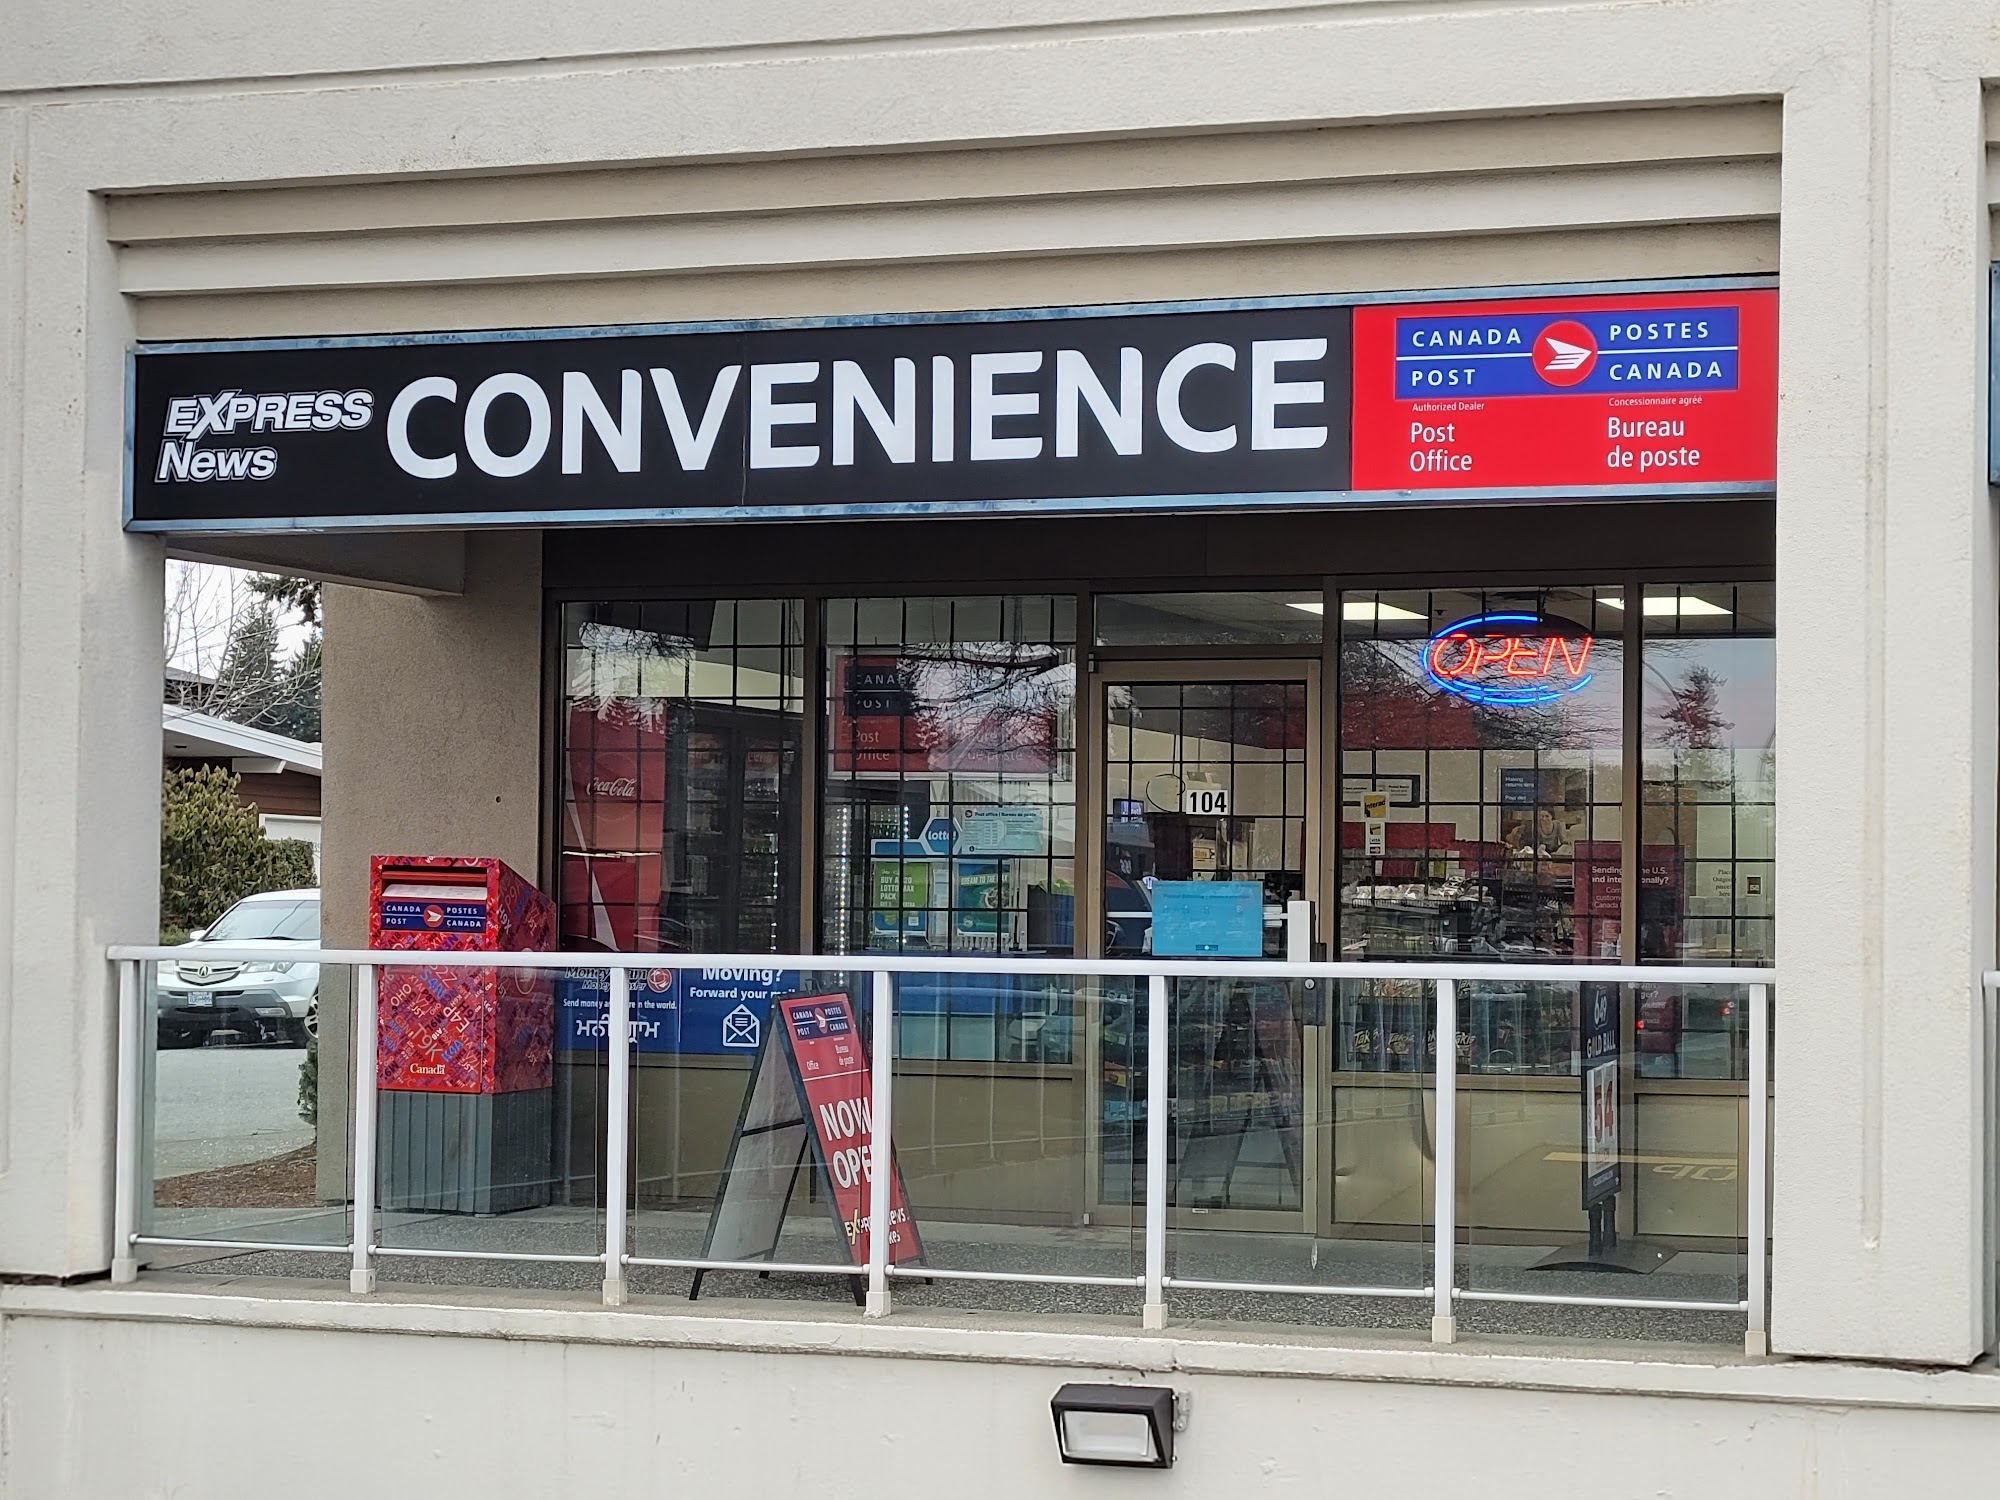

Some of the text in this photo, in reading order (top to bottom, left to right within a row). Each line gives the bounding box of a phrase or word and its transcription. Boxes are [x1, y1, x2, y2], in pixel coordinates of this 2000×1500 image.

[1412, 328, 1522, 348] CANADA
[1609, 321, 1710, 342] POSTES
[1411, 368, 1476, 387] POST
[1609, 361, 1722, 381] CANADA
[387, 338, 1328, 479] CONVENIENCE
[1412, 401, 1485, 413] Authorized Dealer
[1608, 395, 1702, 406] Concessionnaire agréé
[165, 389, 374, 440] EXPRESS
[1410, 422, 1455, 443] Post
[1608, 416, 1685, 438] Bureau
[154, 438, 277, 482] News
[1410, 450, 1473, 472] Office
[1607, 446, 1700, 472] de poste
[1432, 633, 1593, 676] OPEN
[1189, 791, 1227, 813] 104
[1652, 866, 1668, 874] U.S.
[880, 876, 893, 884] BUY
[386, 905, 421, 913] CANADA
[447, 907, 478, 915] POSTES
[447, 920, 481, 928] CANADA
[702, 968, 783, 986] Moving?
[690, 987, 738, 998] Forward
[741, 990, 768, 1001] your
[563, 998, 579, 1007] Send
[581, 1000, 603, 1009] money
[644, 1000, 655, 1008] the
[656, 1000, 678, 1010] world.
[824, 1006, 842, 1015] POSTES
[792, 1010, 813, 1020] CANADA
[797, 1027, 810, 1036] POST
[829, 1022, 848, 1032] CANADA
[410, 1062, 446, 1075] Canada
[819, 1096, 872, 1142] NOW
[832, 1144, 872, 1189] OPE
